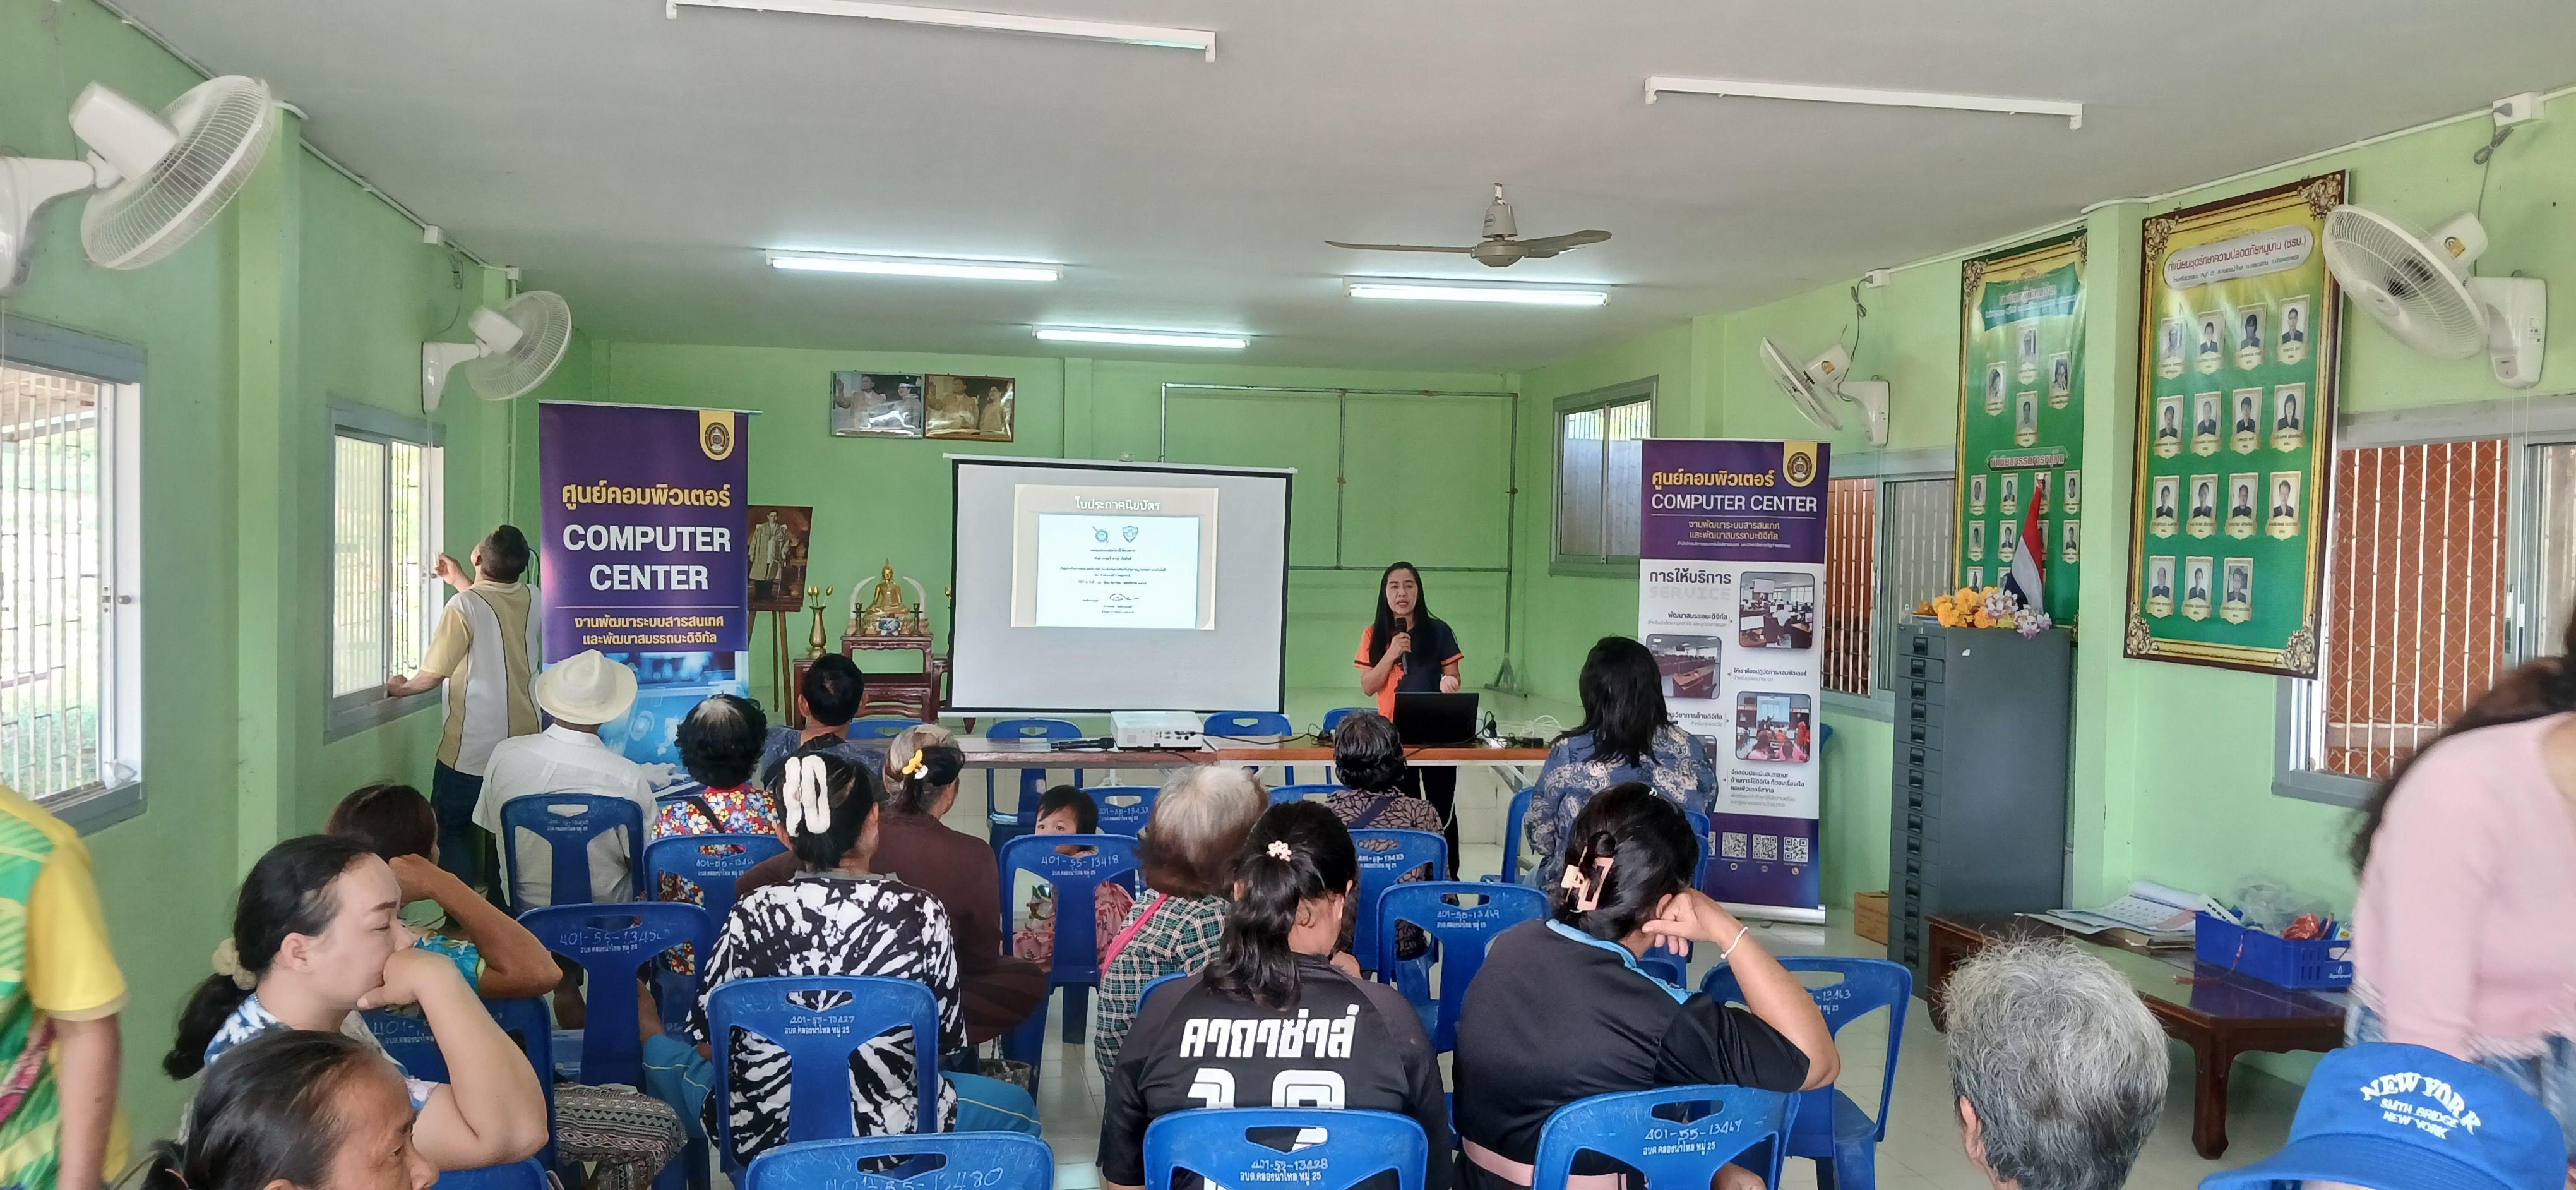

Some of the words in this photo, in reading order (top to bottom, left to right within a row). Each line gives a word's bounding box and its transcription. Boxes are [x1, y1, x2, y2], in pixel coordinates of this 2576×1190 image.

[1652, 468, 1775, 490] ศูนย์คอมพิวเตอร์
[562, 480, 730, 510] ศูนย์คอมพิวเตอร์
[1075, 495, 1160, 511] ใบประกาศนียบัตร
[1651, 493, 1746, 510] COMPUTER
[1750, 495, 1817, 512] CENTER
[1688, 519, 1780, 530] งานพัฒนาระบบสารสนเทศ
[563, 524, 731, 553] COMPUTER
[590, 564, 708, 591] CENTER
[1650, 568, 1731, 584] การให้บริการ
[1649, 586, 1731, 600] SERVICE
[575, 614, 724, 628] งานพัฒนาระบบสารสนเทศ
[583, 631, 717, 645] และพัฒนาสมรรถนะดิจิทัล
[1041, 854, 1119, 868] 401-55-13418
[2359, 1072, 2421, 1101] NEW
[2420, 1076, 2481, 1135] YORK
[2382, 1111, 2412, 1125] NEW
[2414, 1119, 2450, 1139] YORK
[1696, 1139, 1706, 1156] หมู่
[1707, 1141, 1715, 1150] 25
[1251, 1158, 1328, 1172] 401-55-13428
[1299, 1169, 1310, 1186] หมู่
[1312, 1171, 1321, 1181] 25
